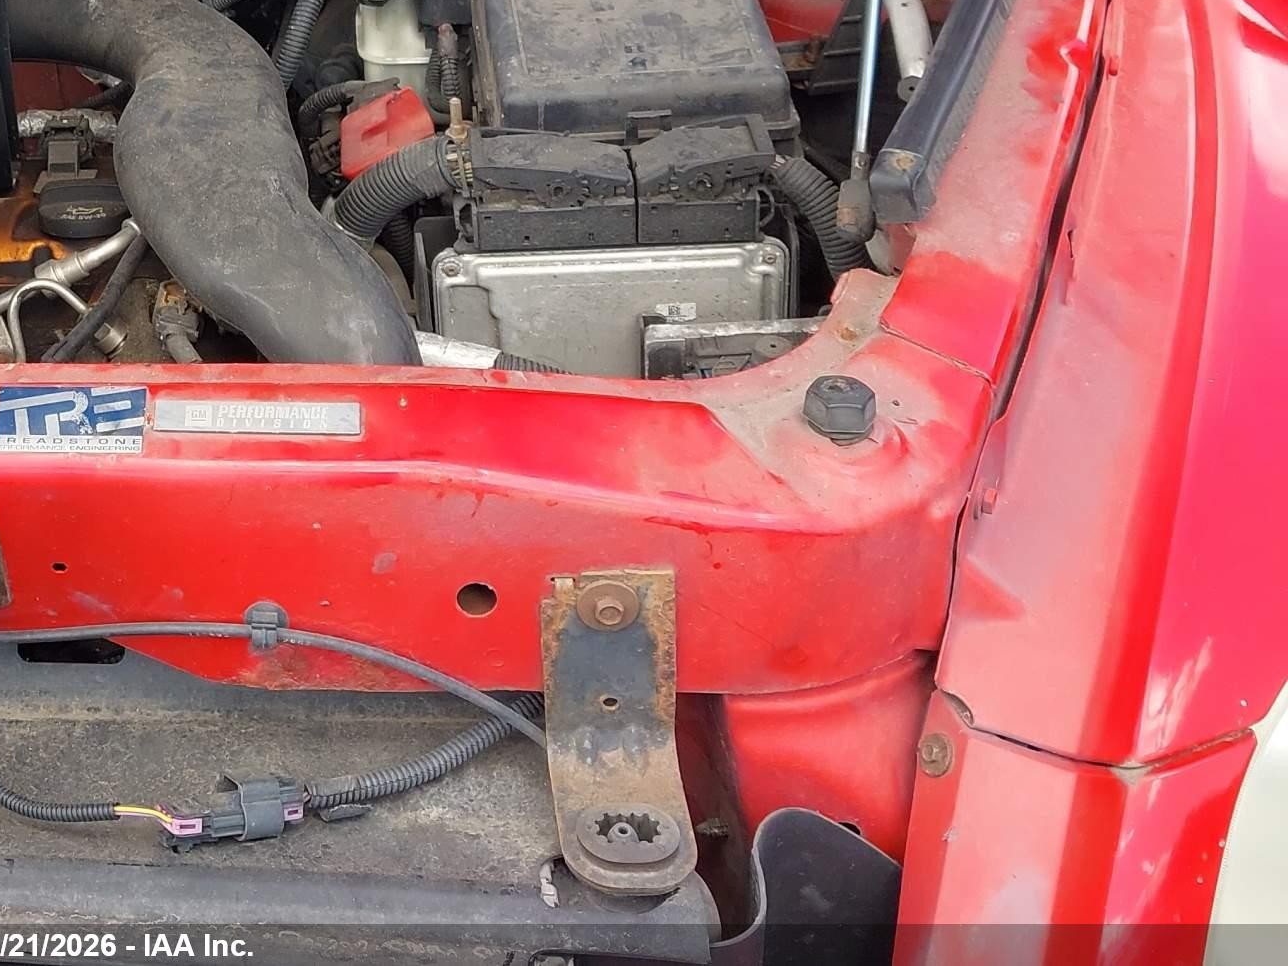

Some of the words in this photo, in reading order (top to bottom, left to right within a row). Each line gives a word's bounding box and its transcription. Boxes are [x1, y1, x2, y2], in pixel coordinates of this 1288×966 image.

[192, 409, 208, 420] GM
[217, 404, 329, 419] PERFORMANCE
[216, 418, 328, 428] DIVISION
